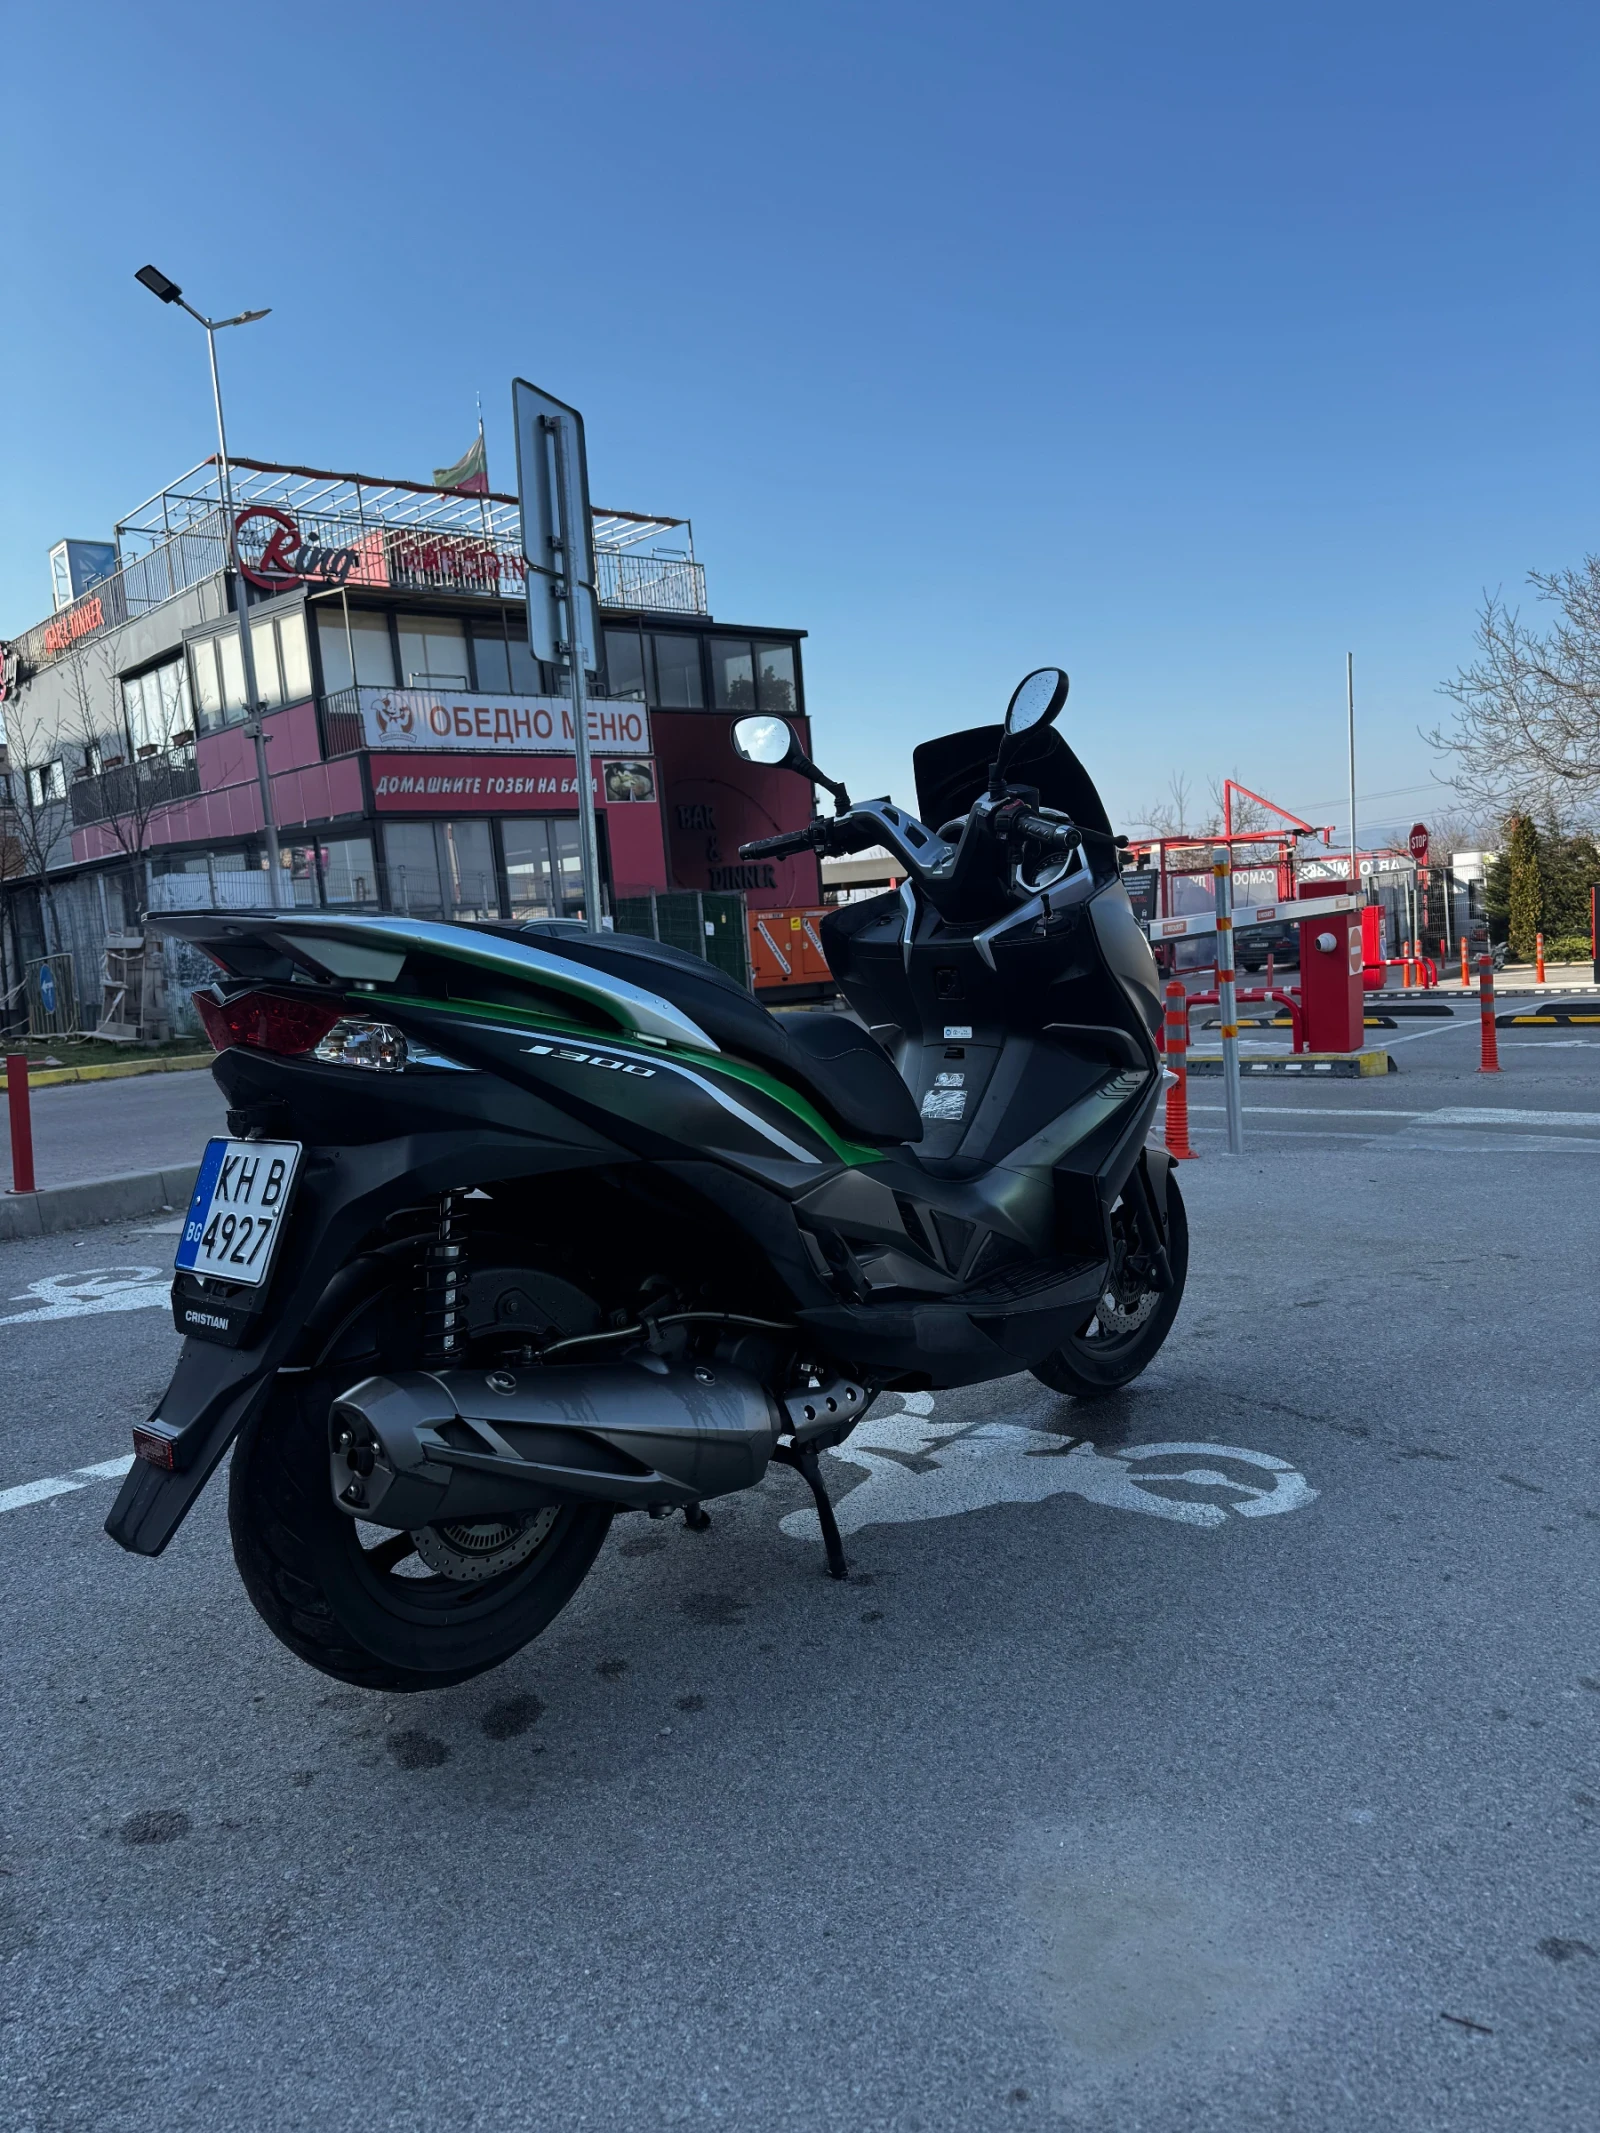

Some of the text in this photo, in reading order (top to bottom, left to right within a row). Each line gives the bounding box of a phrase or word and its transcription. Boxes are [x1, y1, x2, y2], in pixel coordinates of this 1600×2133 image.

[260, 528, 358, 584] Ring
[481, 551, 526, 581] DIN
[68, 597, 105, 638] DINNER
[430, 705, 553, 743] ОБЕДНО
[376, 775, 598, 796] ДОМАШНИТЕ ГОЗБИ НА БАА
[675, 804, 717, 830] BAR
[1411, 834, 1427, 850] STOP
[708, 864, 777, 891] DINNER
[519, 1045, 657, 1078] J300
[215, 1154, 286, 1206] KH B
[185, 1211, 274, 1265] BG 4927
[185, 1310, 229, 1330] CRISTIANI
